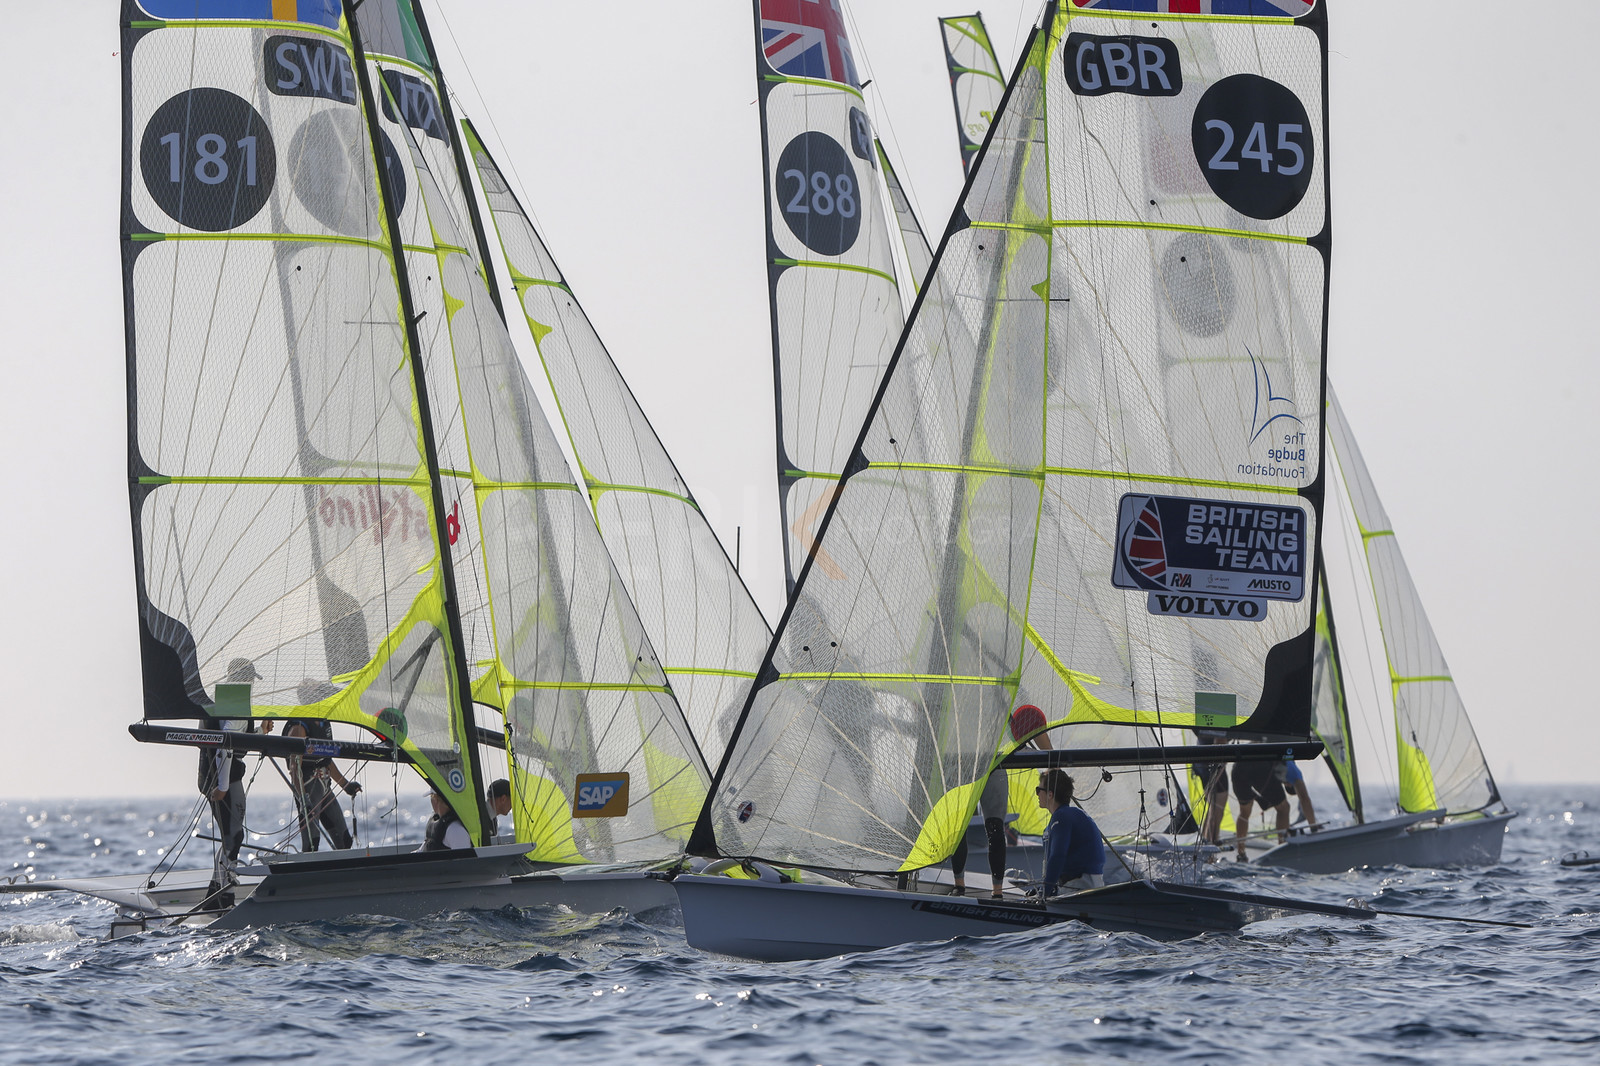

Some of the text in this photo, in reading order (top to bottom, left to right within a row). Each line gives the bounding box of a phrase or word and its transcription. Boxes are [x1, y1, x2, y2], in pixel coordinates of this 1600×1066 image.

[275, 42, 354, 98] SWE
[1075, 40, 1172, 90] GBR
[160, 131, 257, 186] 181
[1204, 118, 1307, 176] 245
[783, 168, 857, 220] 288
[1188, 504, 1298, 531] BRITISH
[1185, 525, 1298, 551] SAILING
[1216, 548, 1298, 572] TEAM
[1170, 572, 1192, 588] RYA
[1247, 578, 1291, 591] MUSTO
[1155, 594, 1259, 618] VOLVO
[166, 732, 224, 743] MAGIC MARINE
[579, 786, 614, 806] SAP
[930, 902, 986, 917] BRITISH
[989, 911, 1043, 924] SAILING
